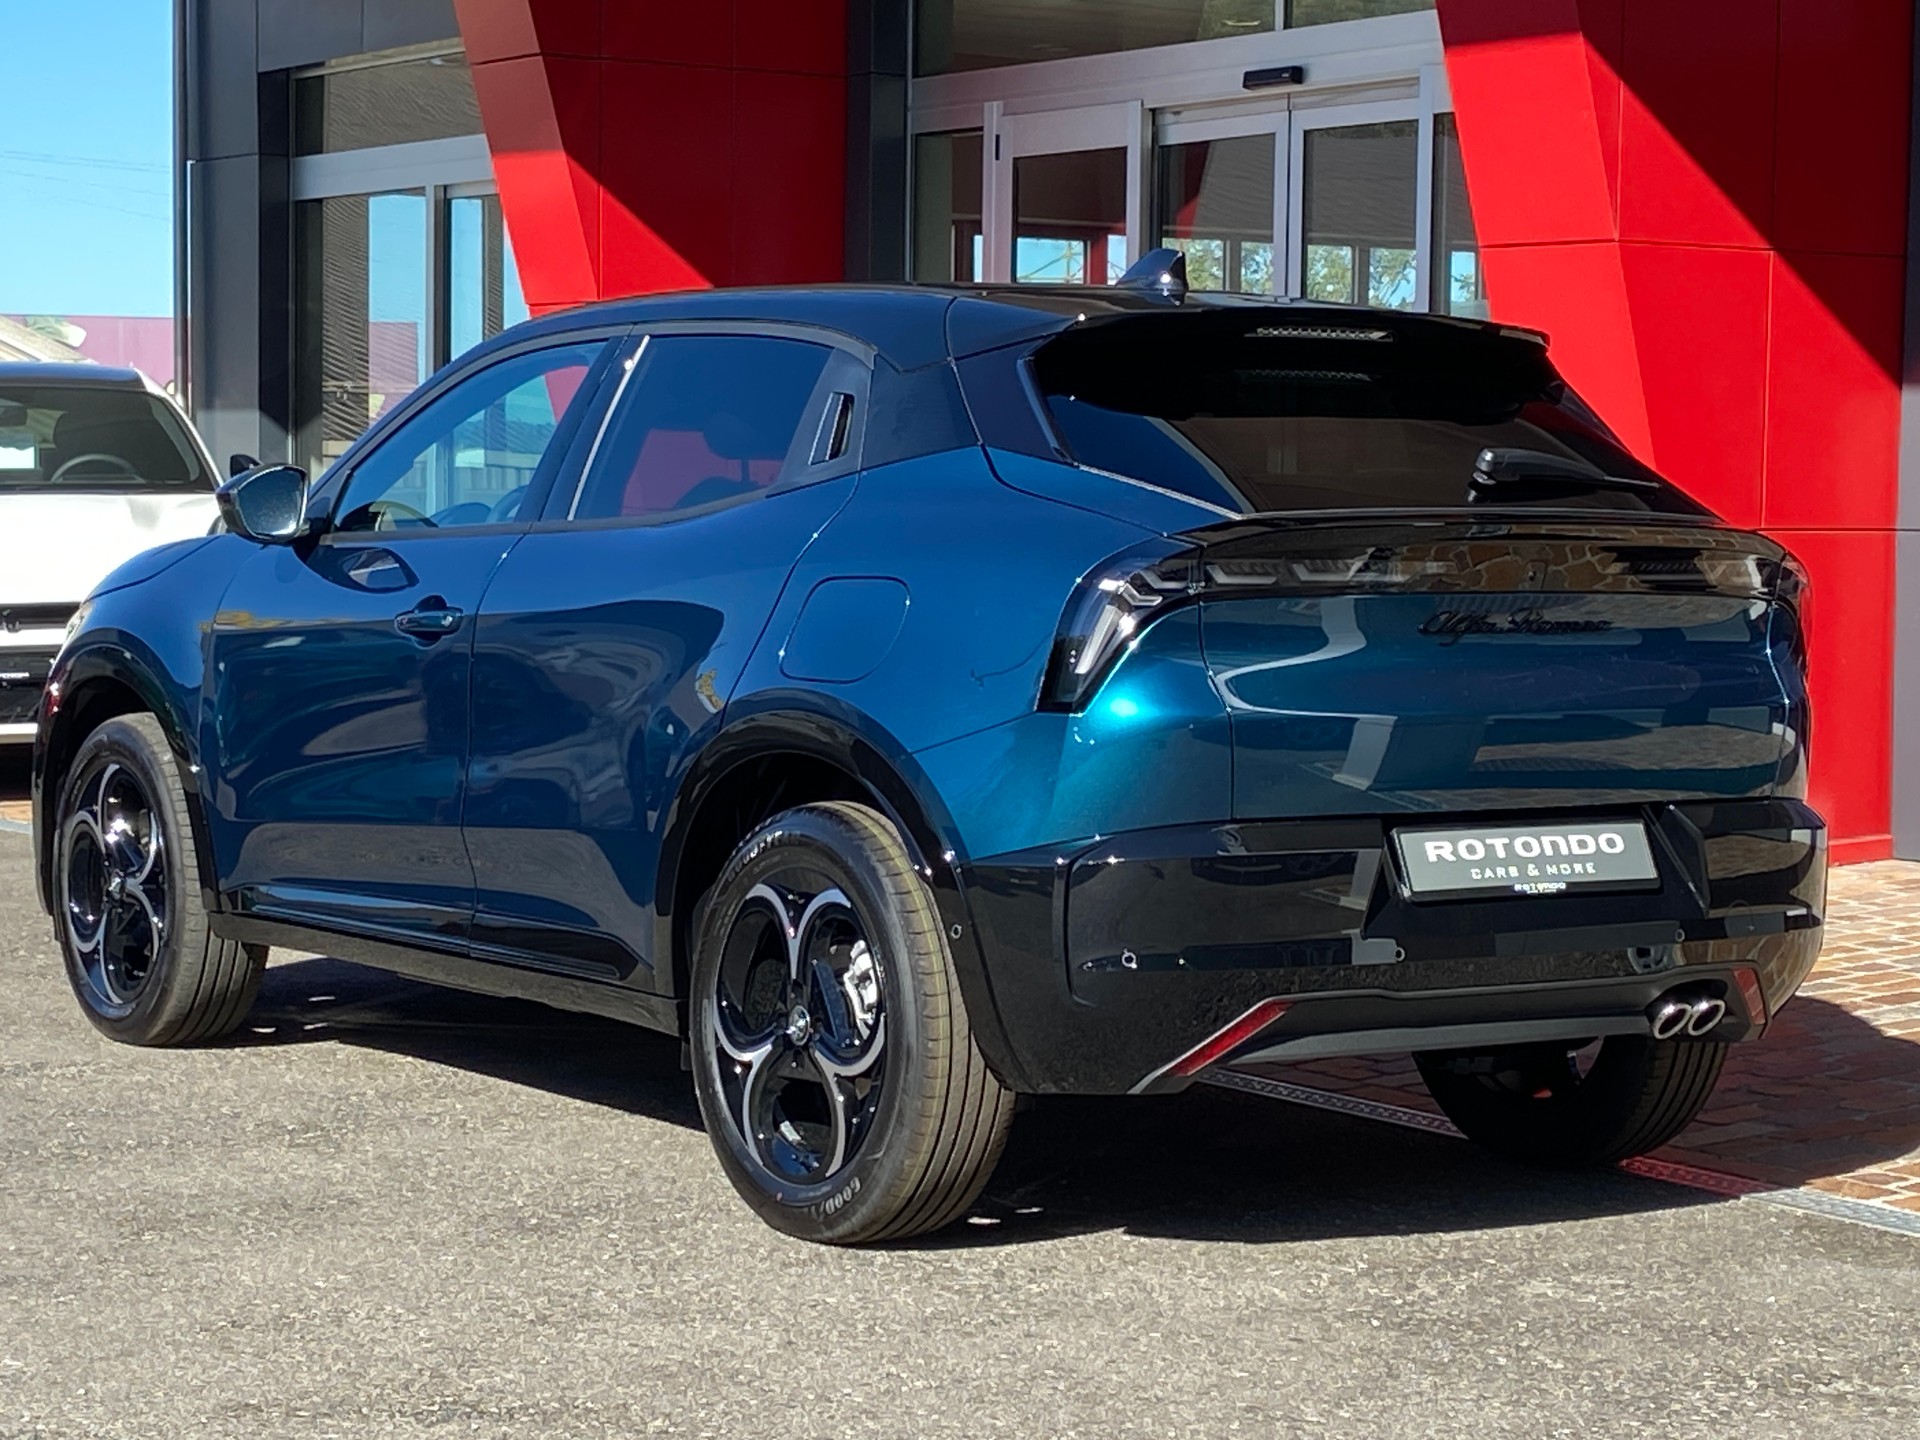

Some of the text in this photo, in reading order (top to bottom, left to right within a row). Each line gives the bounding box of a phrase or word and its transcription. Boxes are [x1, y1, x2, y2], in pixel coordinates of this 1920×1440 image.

[1424, 833, 1625, 862] ROTONDO
[1470, 862, 1596, 879] CARS & MORE
